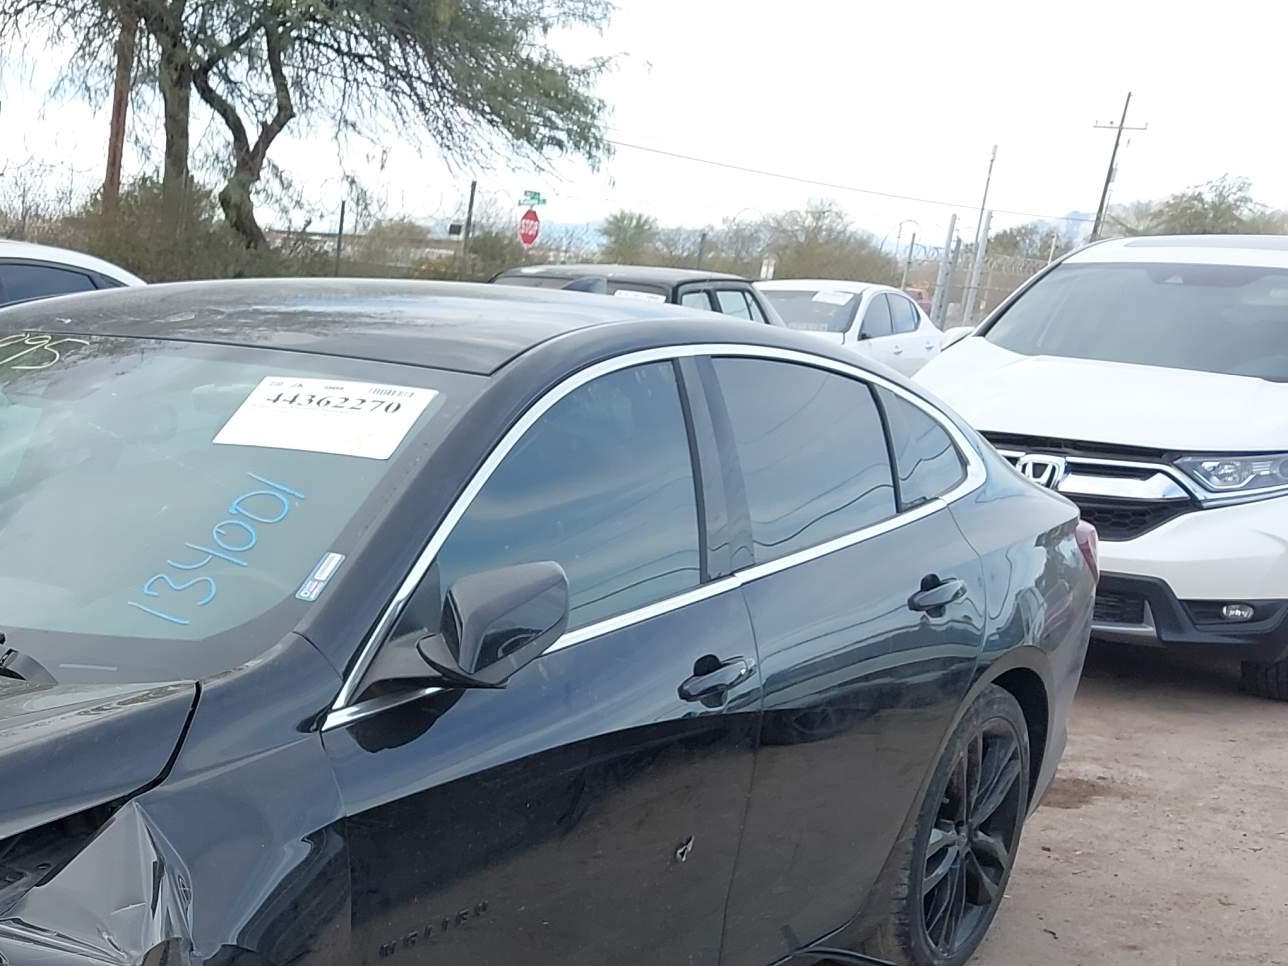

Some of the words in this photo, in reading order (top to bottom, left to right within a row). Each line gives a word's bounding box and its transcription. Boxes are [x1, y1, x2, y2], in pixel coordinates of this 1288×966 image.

[521, 219, 538, 235] STOP
[266, 392, 402, 414] 44362270
[128, 472, 305, 625] 134001
